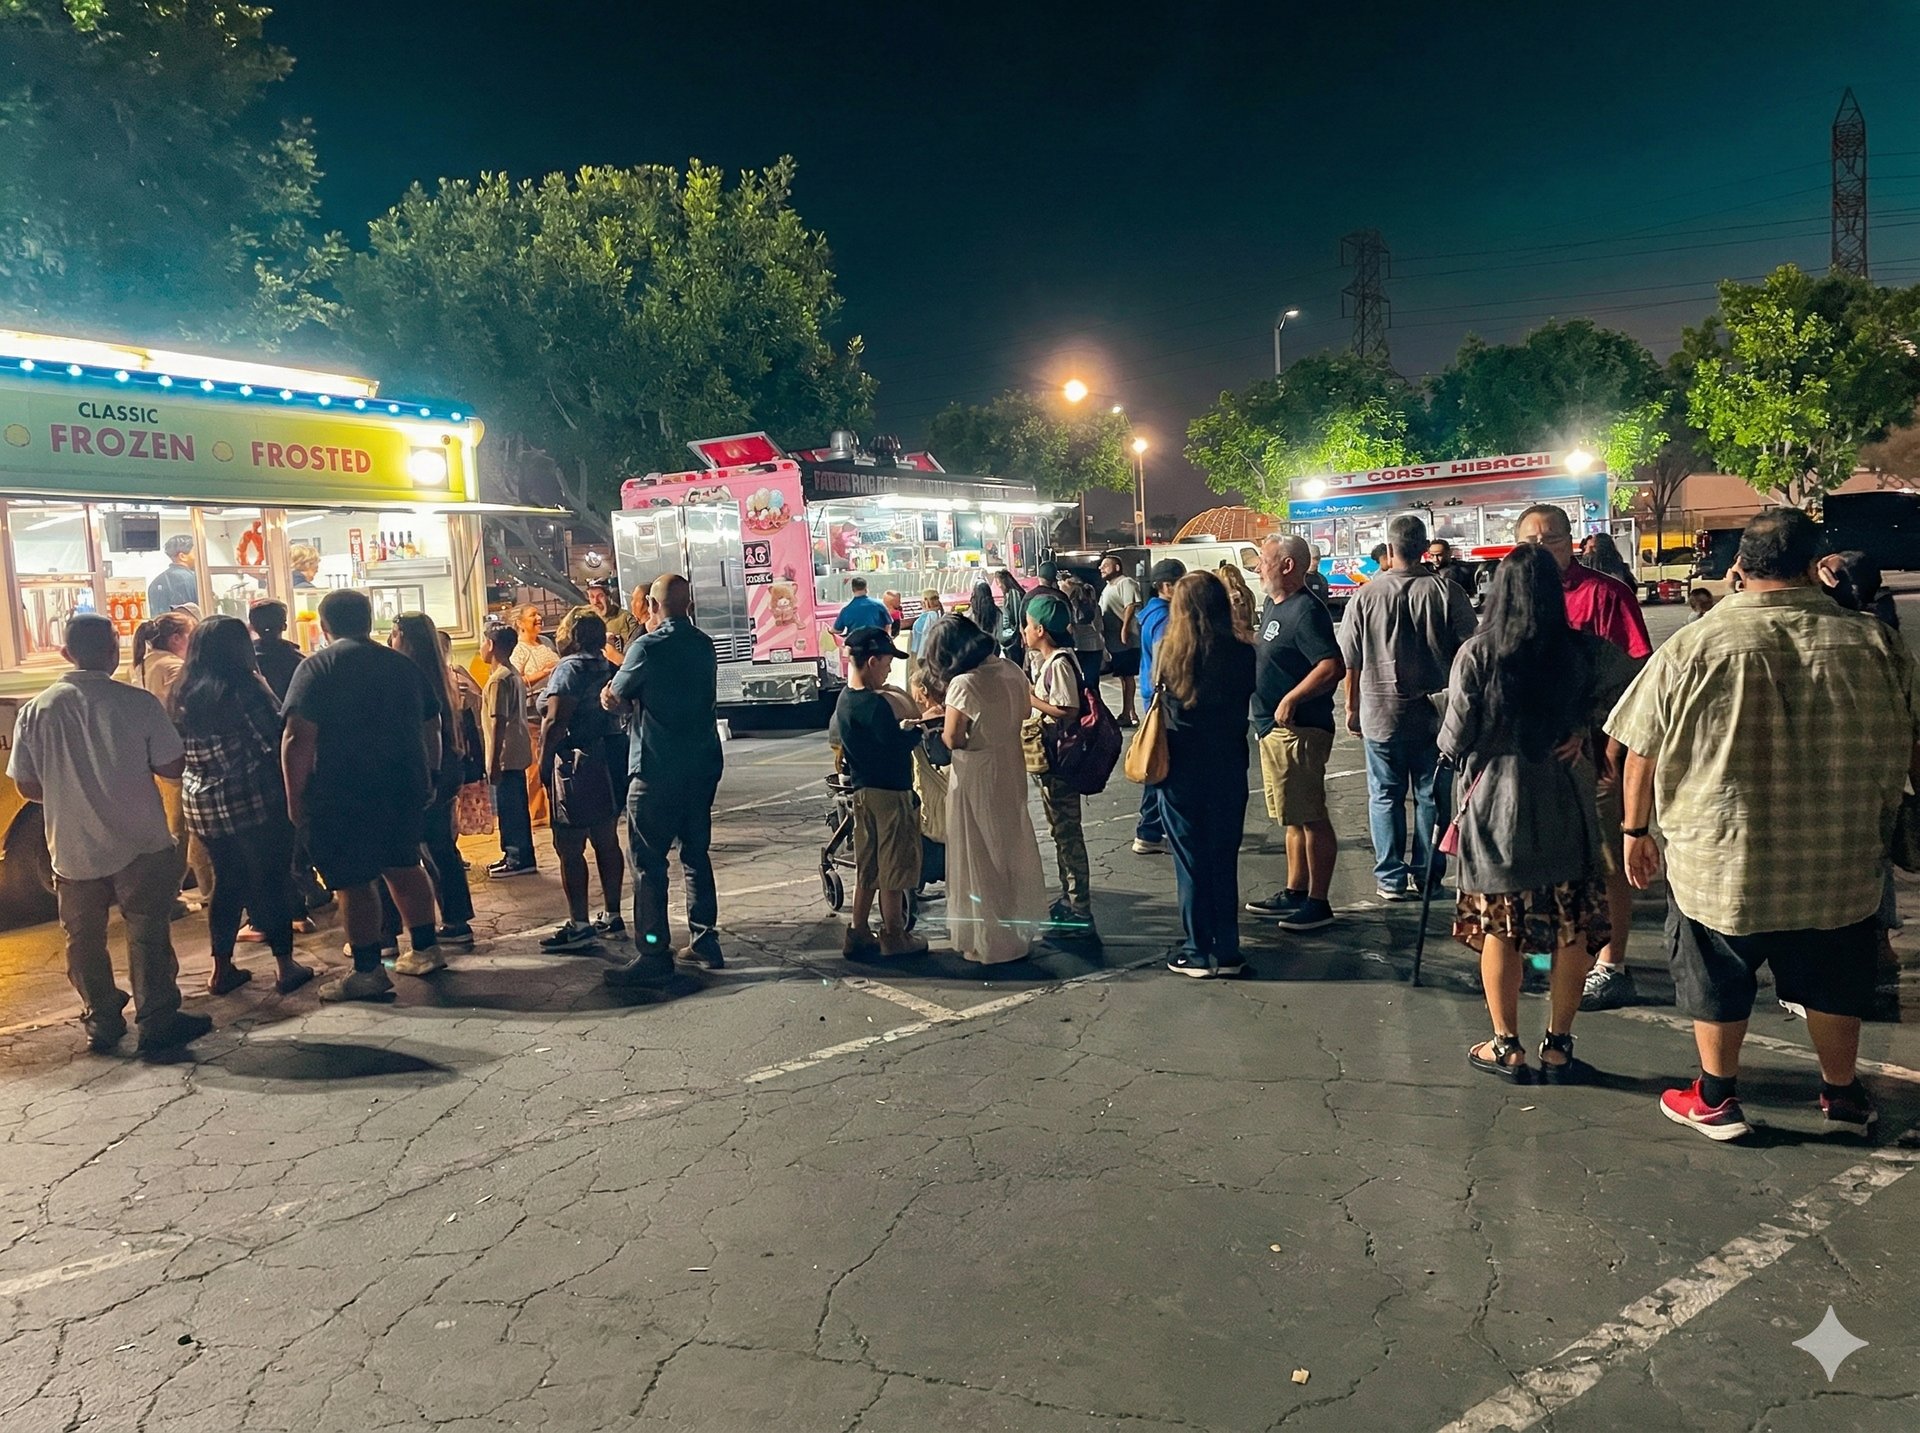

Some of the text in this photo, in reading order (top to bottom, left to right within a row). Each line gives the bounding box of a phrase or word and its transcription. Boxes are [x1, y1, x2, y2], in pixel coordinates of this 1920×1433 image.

[78, 401, 159, 424] CLASSIC
[50, 423, 195, 462] FROZEN
[251, 441, 372, 474] FROSTED
[1367, 465, 1441, 483] COAST
[1451, 454, 1551, 474] HIBACHI
